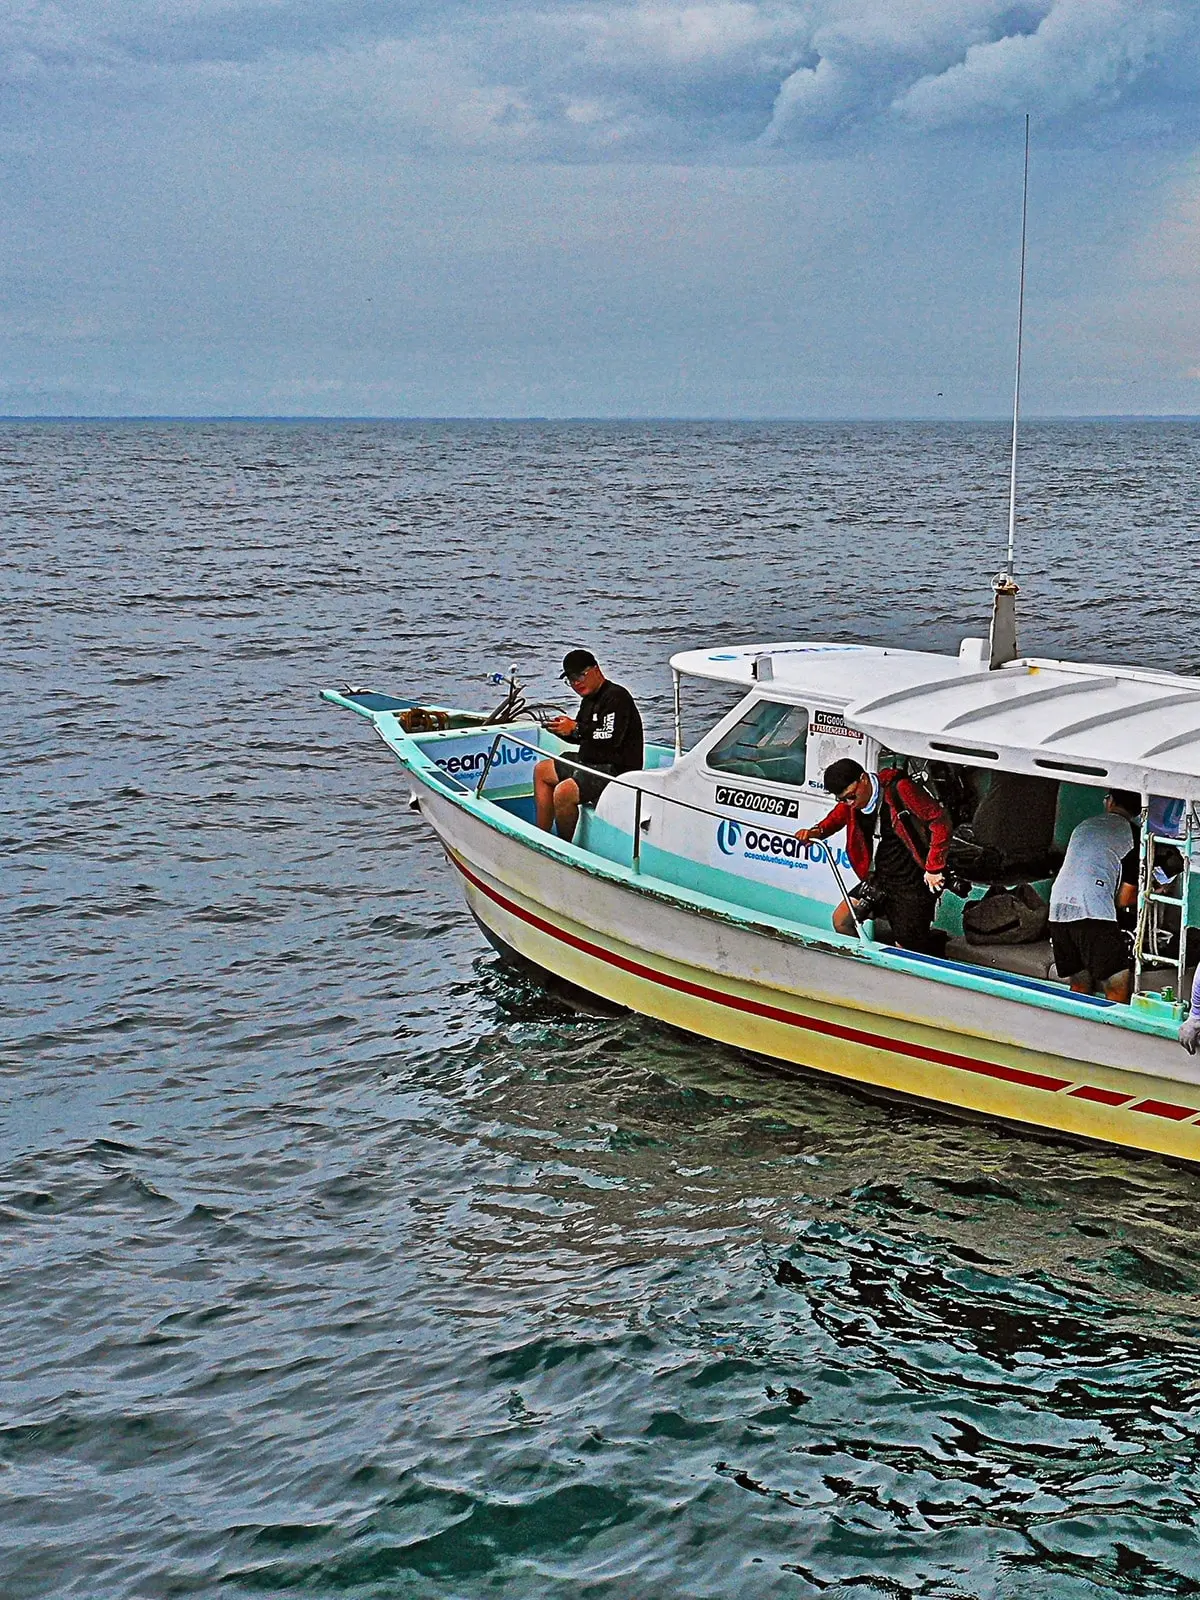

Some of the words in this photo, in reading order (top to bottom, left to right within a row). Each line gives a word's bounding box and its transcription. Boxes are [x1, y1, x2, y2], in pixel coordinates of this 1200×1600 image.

[716, 788, 784, 815] CTG00096
[786, 802, 798, 817] P
[744, 851, 809, 870] oceanbluefishing.com
